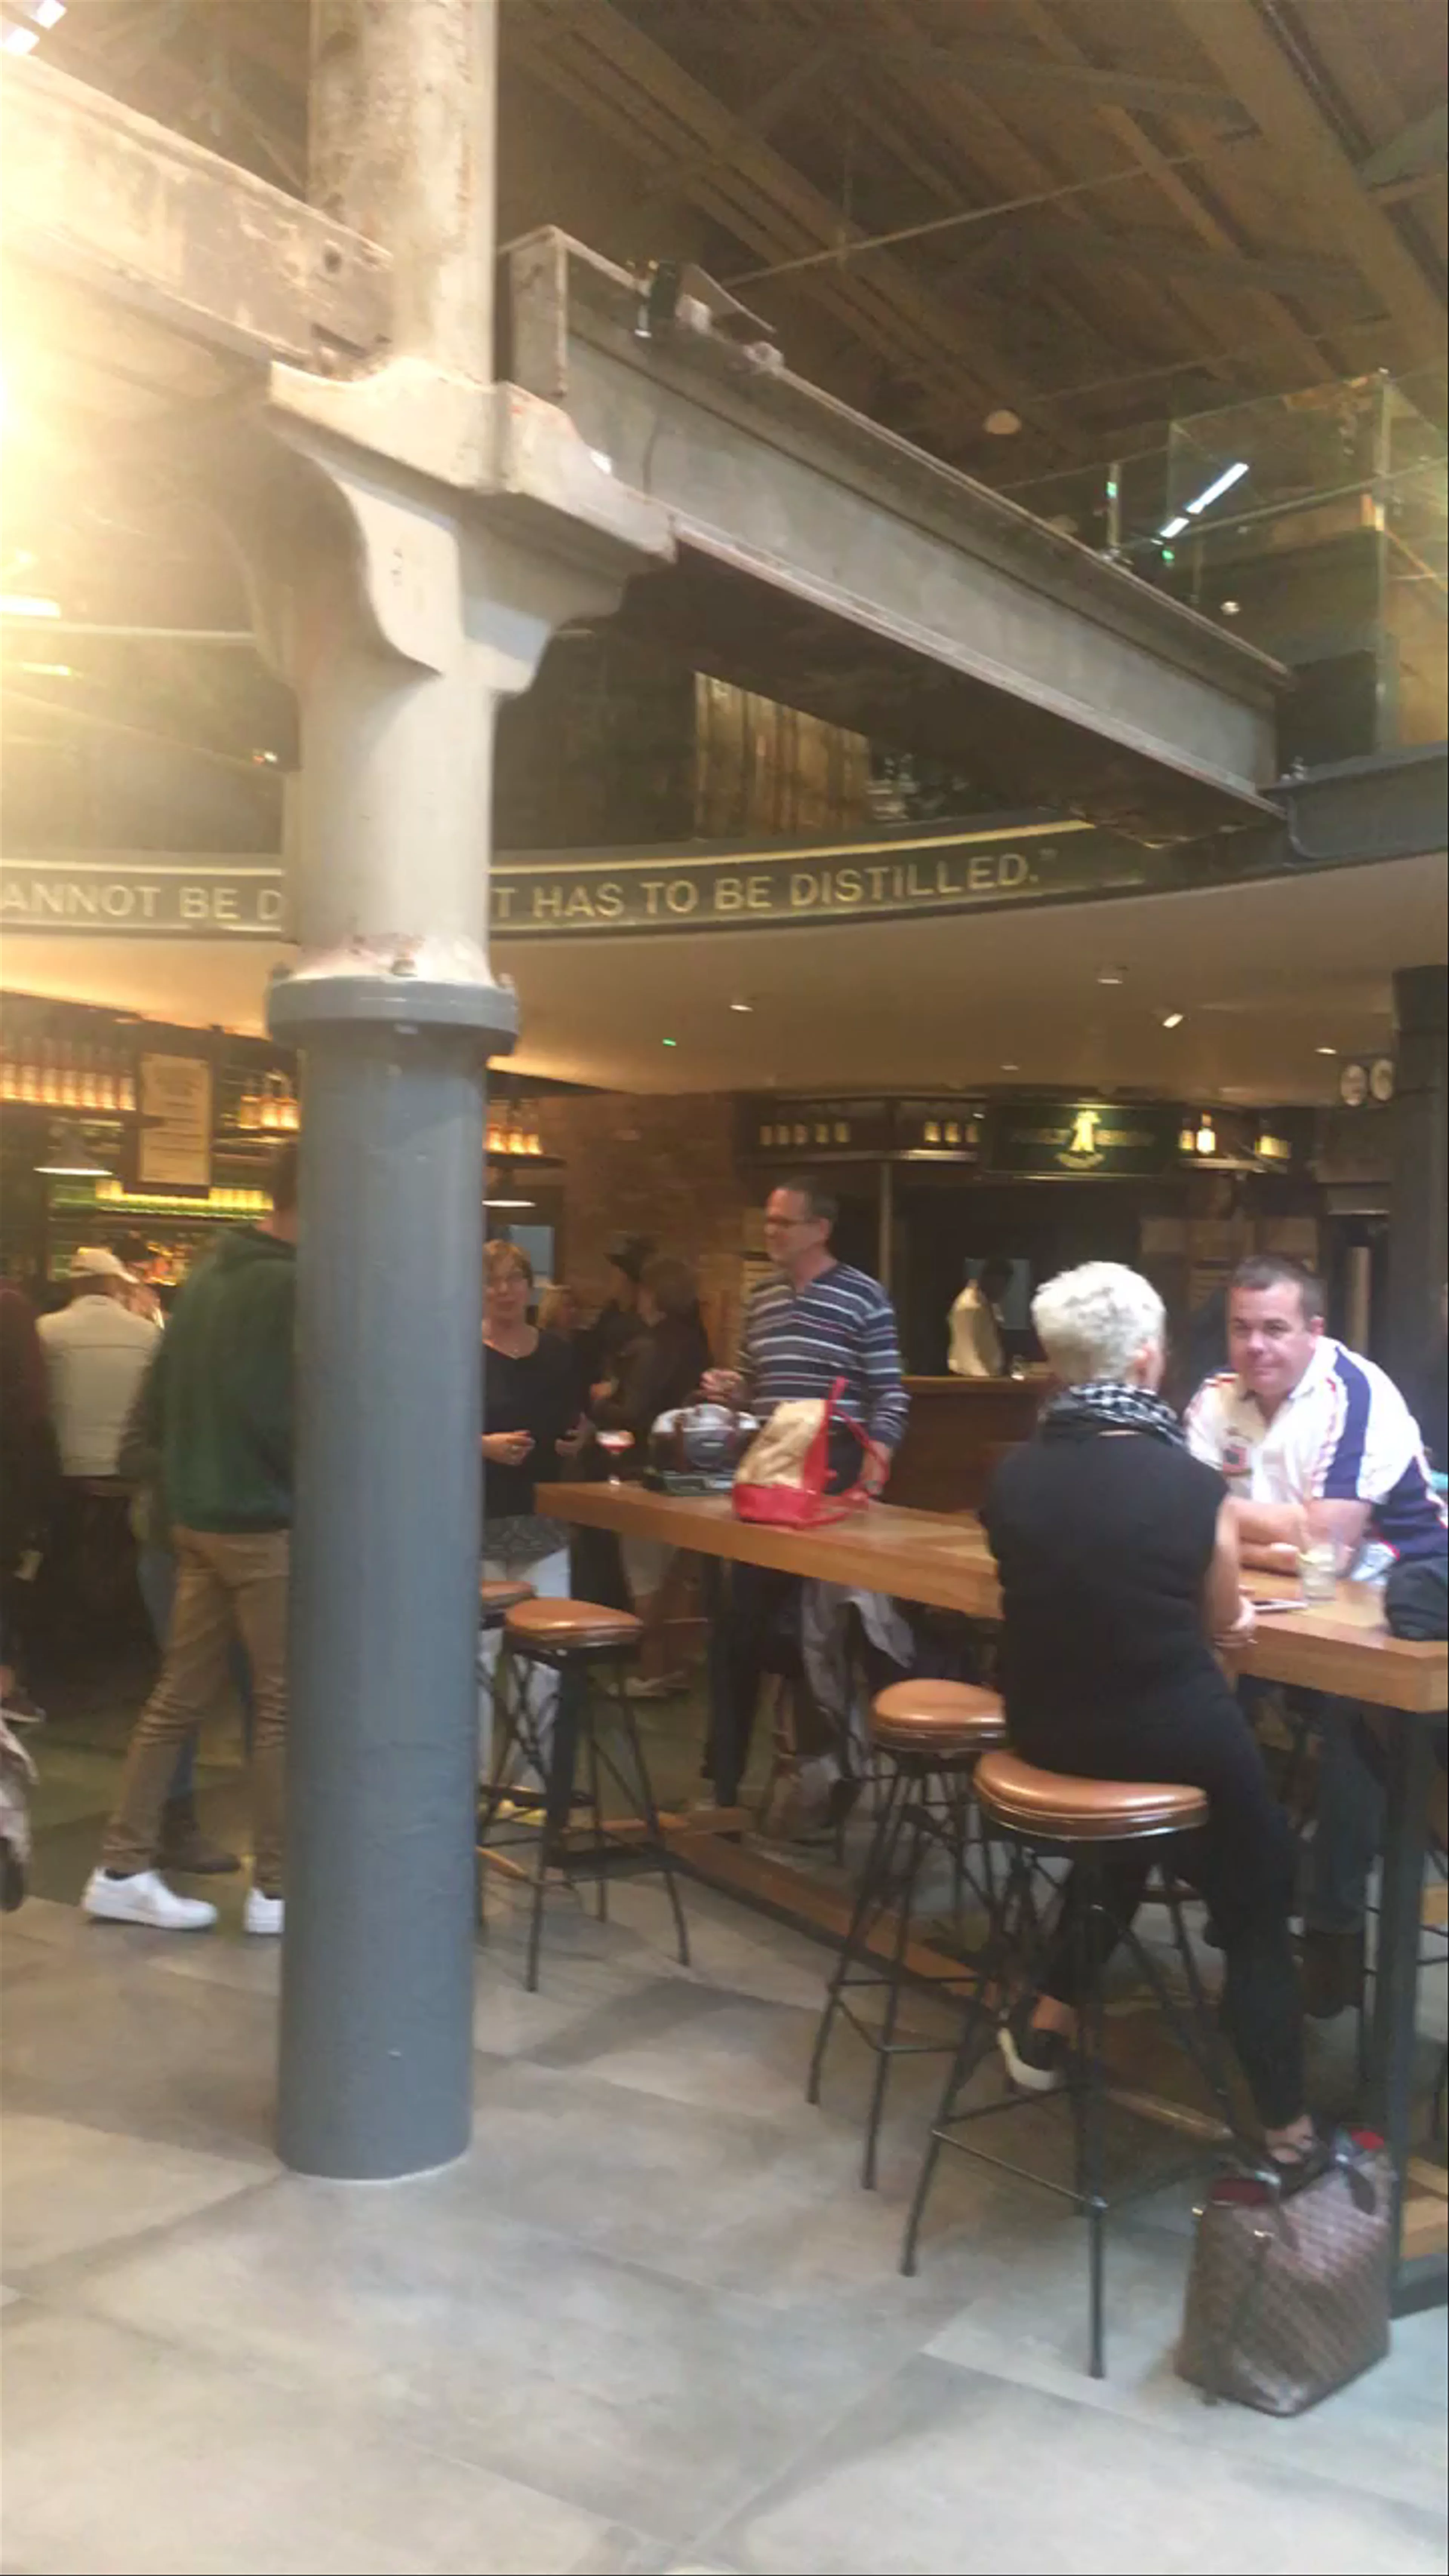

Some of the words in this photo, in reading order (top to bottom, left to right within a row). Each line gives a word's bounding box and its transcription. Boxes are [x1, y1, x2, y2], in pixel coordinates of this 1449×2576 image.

[1, 881, 161, 917] ANNOT
[179, 887, 240, 919] BE
[532, 883, 624, 917] HAS
[640, 880, 698, 914] TO
[714, 876, 772, 910] BE
